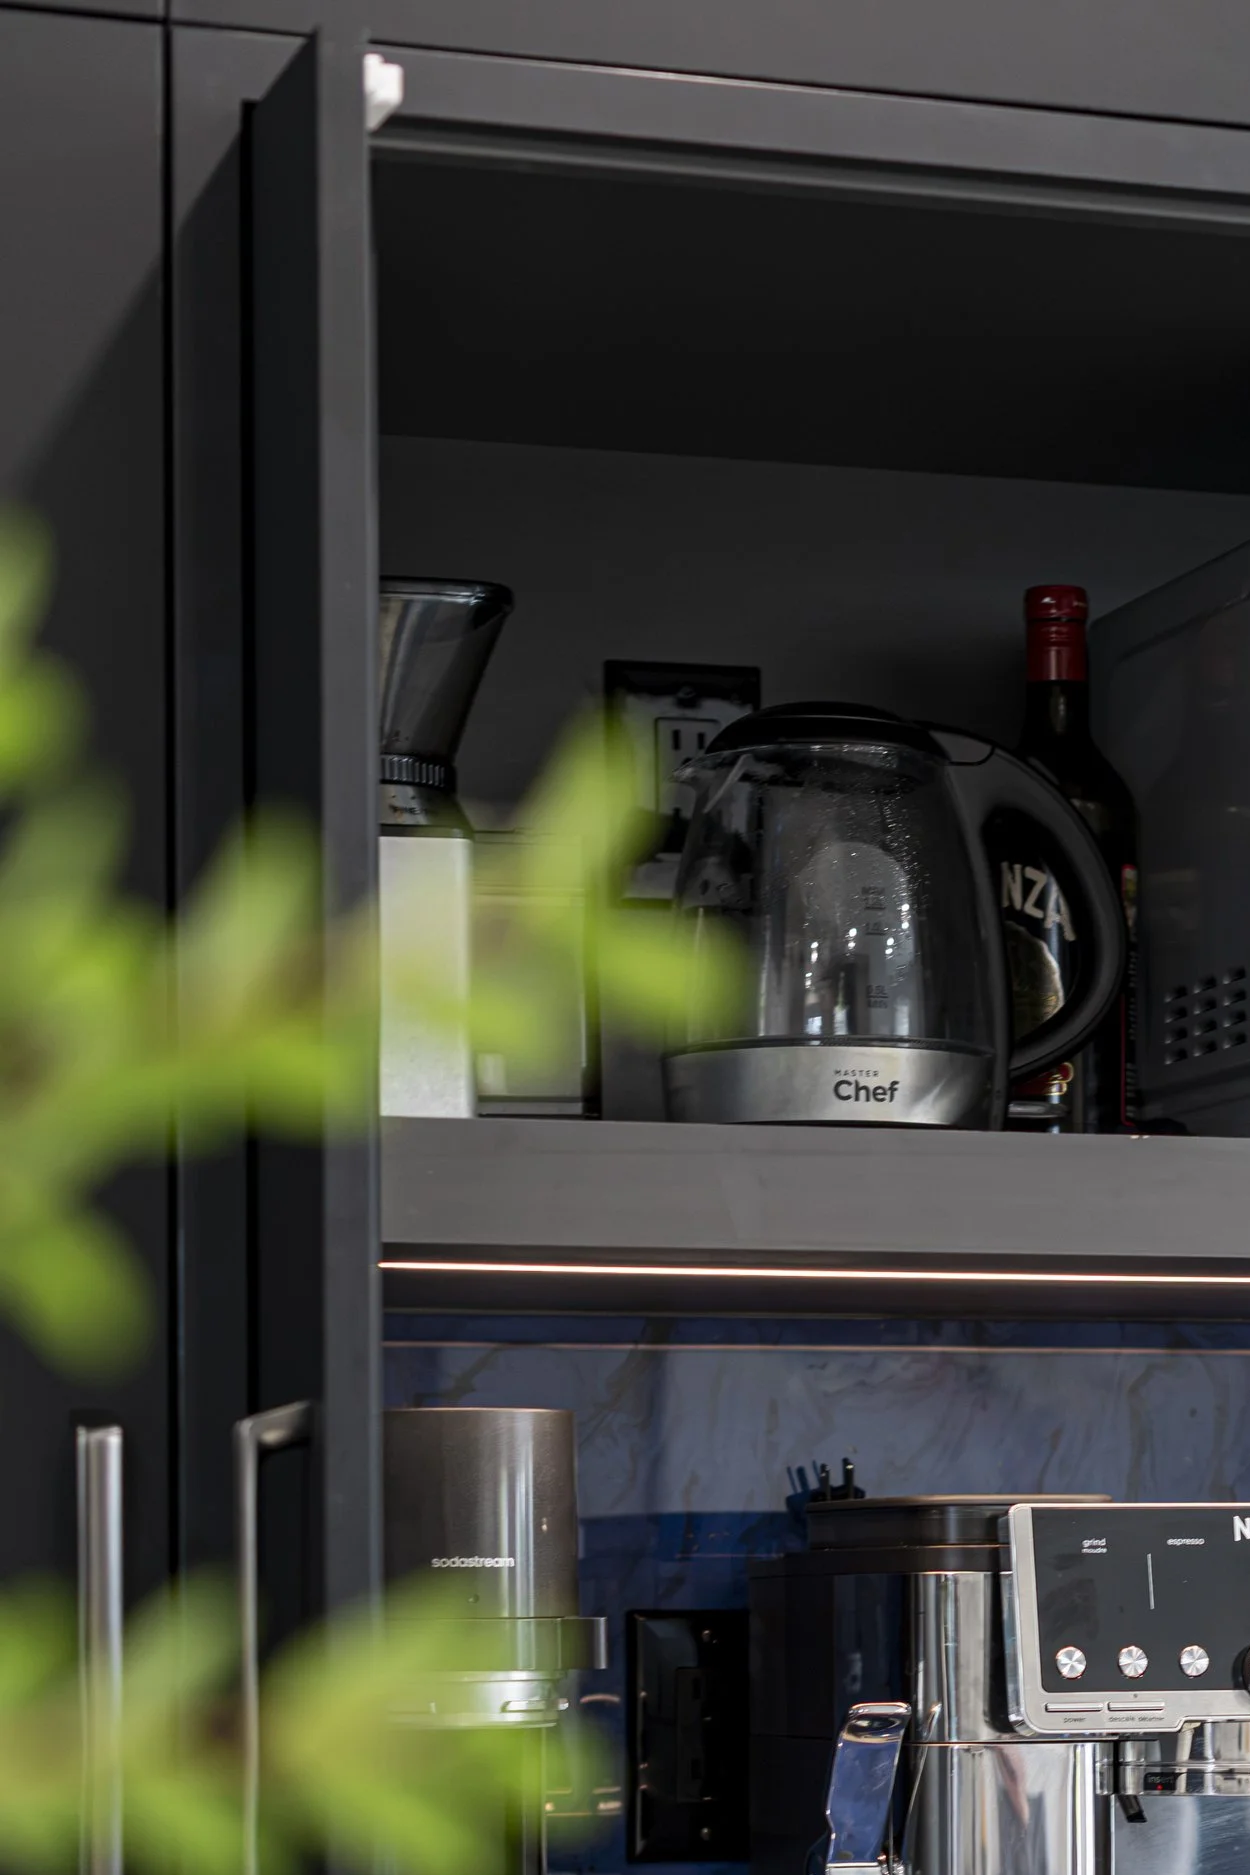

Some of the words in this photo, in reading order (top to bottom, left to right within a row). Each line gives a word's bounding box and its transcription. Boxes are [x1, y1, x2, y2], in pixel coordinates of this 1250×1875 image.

[1001, 861, 1076, 941] NZA
[834, 1069, 879, 1077] MASTER
[833, 1079, 900, 1103] Chef
[1082, 1538, 1107, 1547] grind
[1166, 1538, 1205, 1546] espresso
[431, 1555, 515, 1568] sodastream
